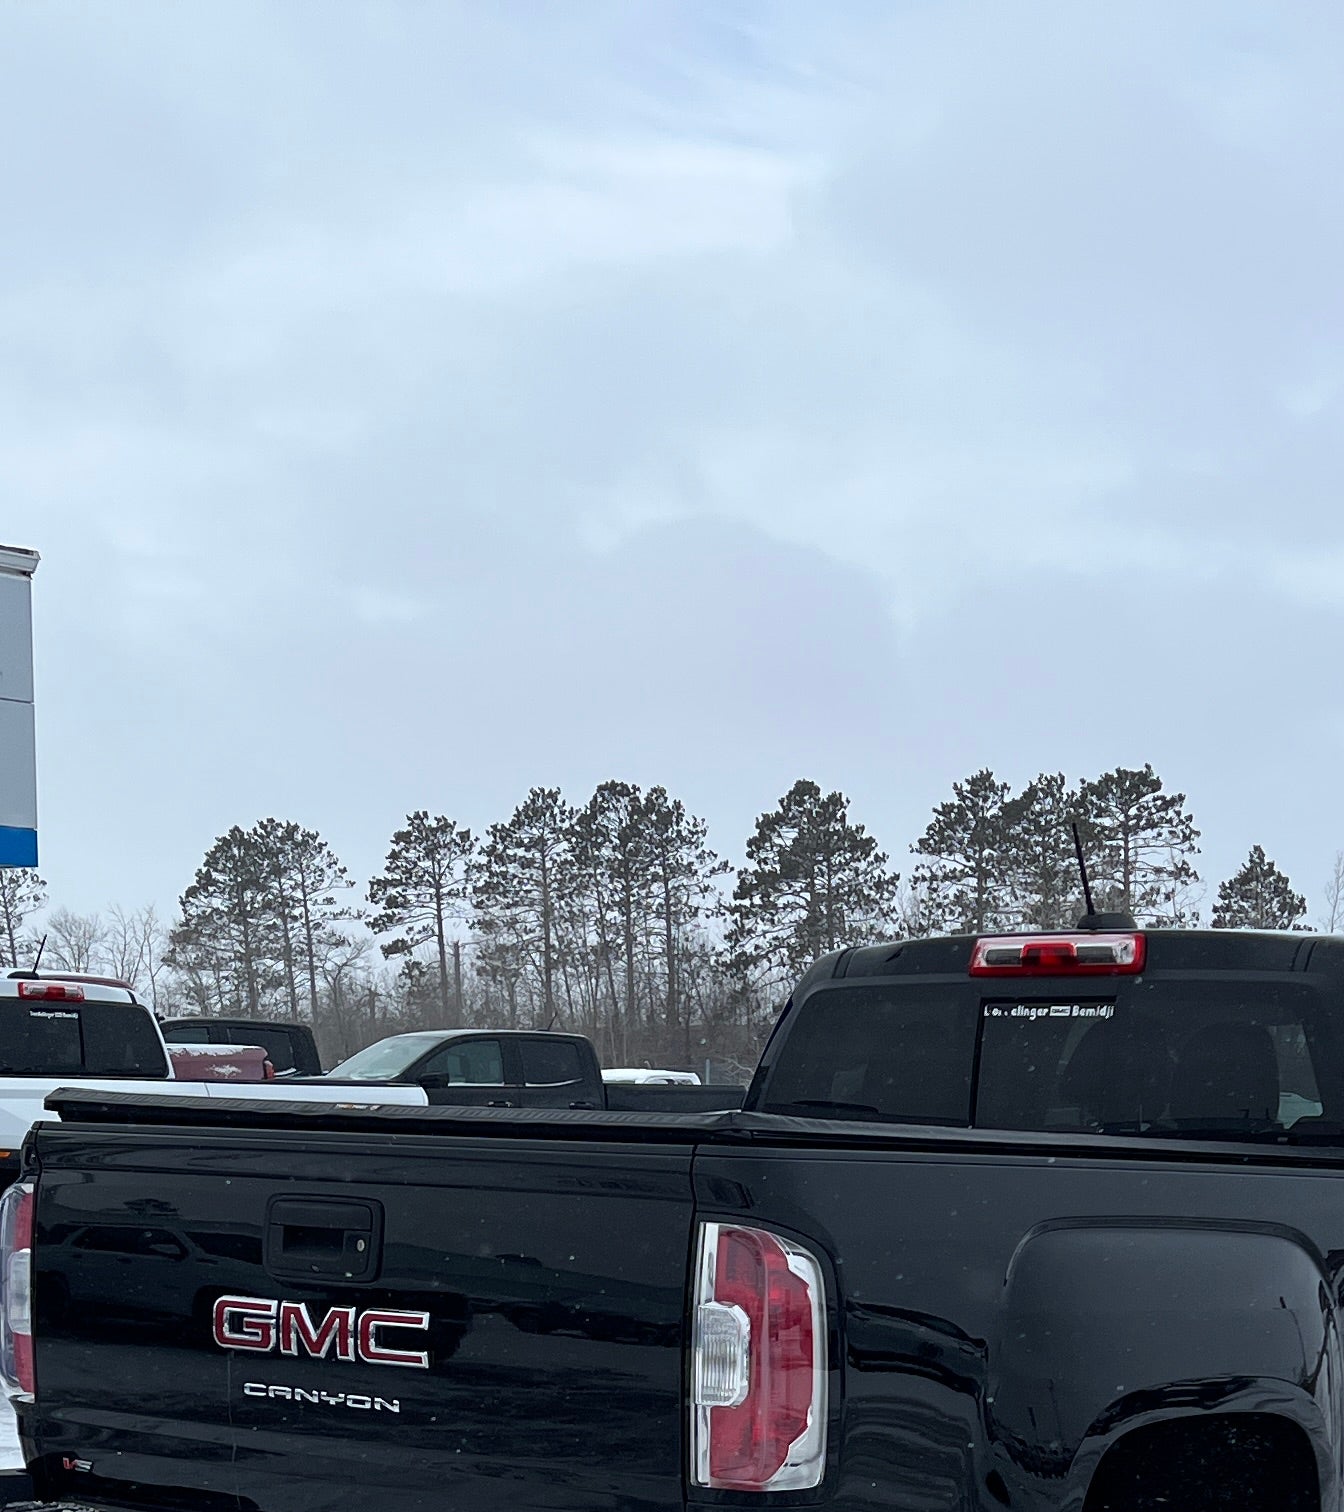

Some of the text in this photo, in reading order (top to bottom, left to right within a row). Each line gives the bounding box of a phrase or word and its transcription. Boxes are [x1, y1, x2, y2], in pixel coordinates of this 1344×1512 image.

[1072, 1005, 1115, 1019] Bemidji
[213, 1295, 430, 1369] GMC
[244, 1382, 400, 1413] CANYON
